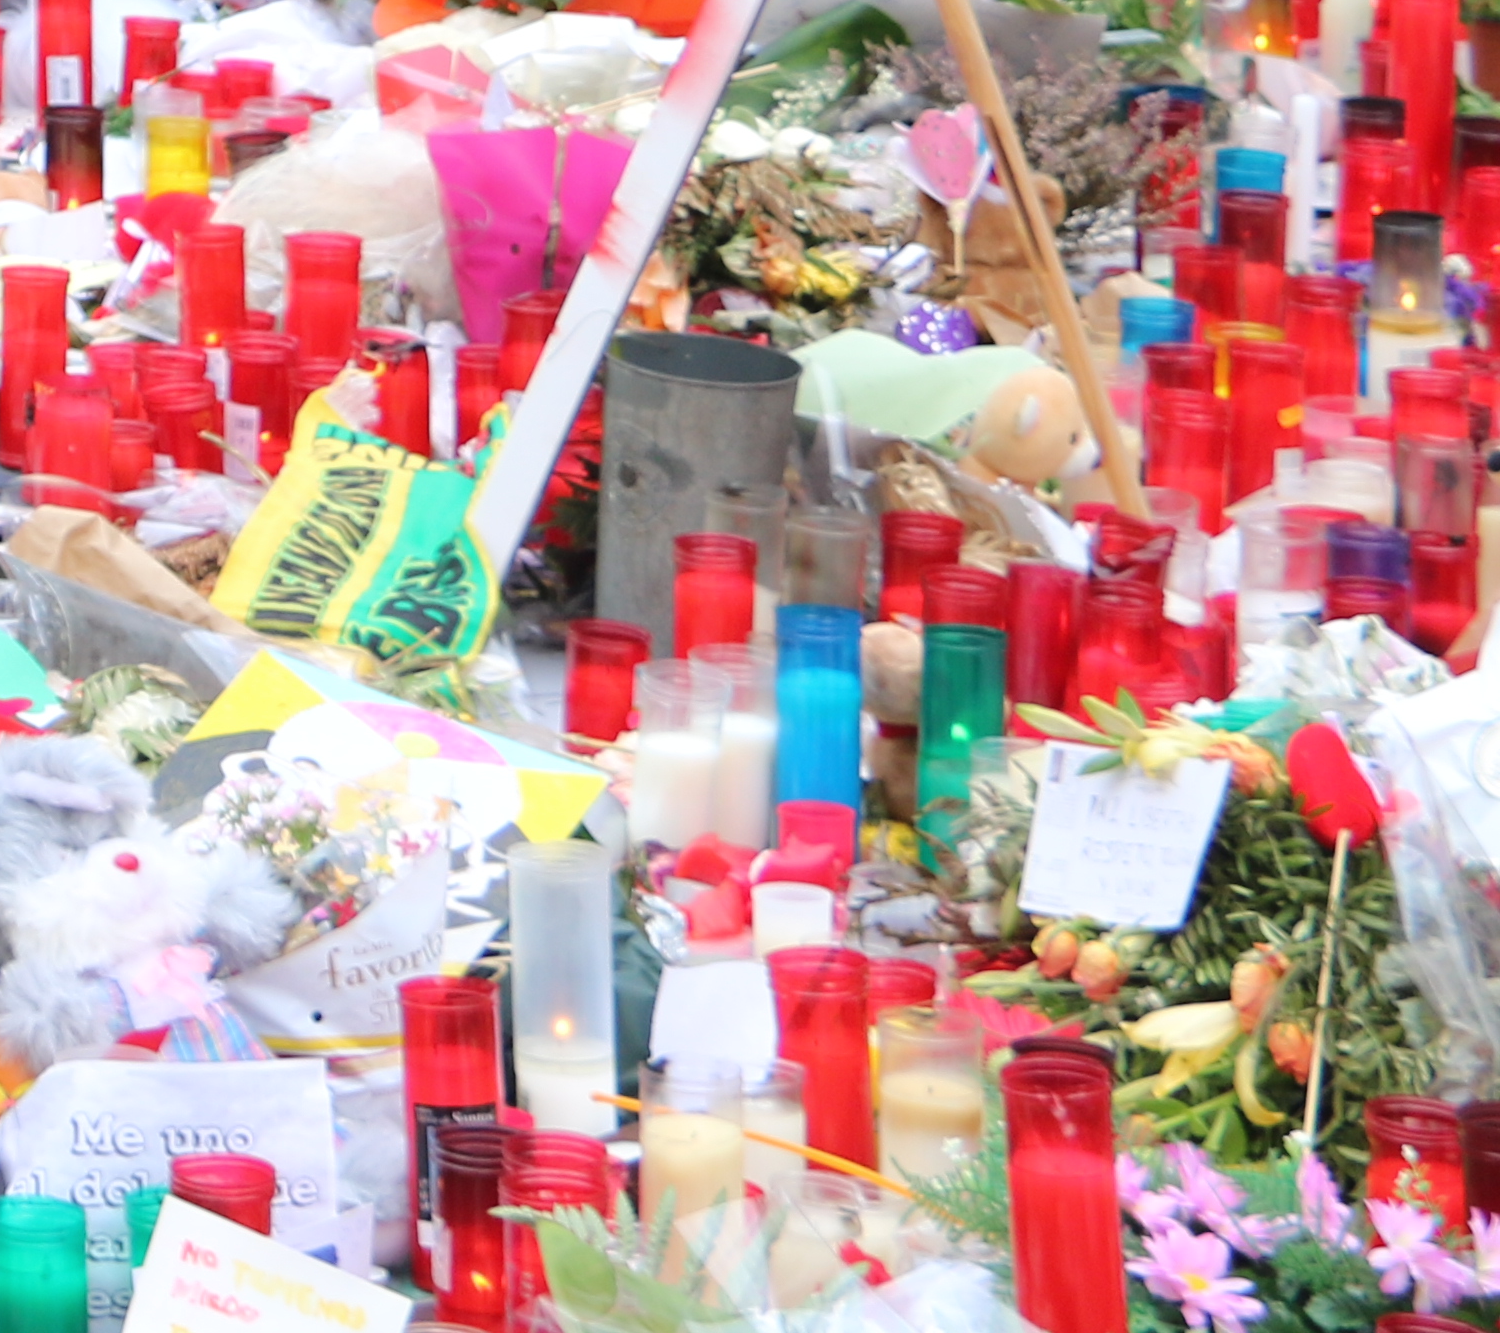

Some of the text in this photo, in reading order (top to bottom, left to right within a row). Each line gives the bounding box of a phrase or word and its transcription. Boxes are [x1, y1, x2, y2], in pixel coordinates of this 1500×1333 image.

[70, 1111, 254, 1156] Me uno
[180, 1237, 219, 1269] NO
